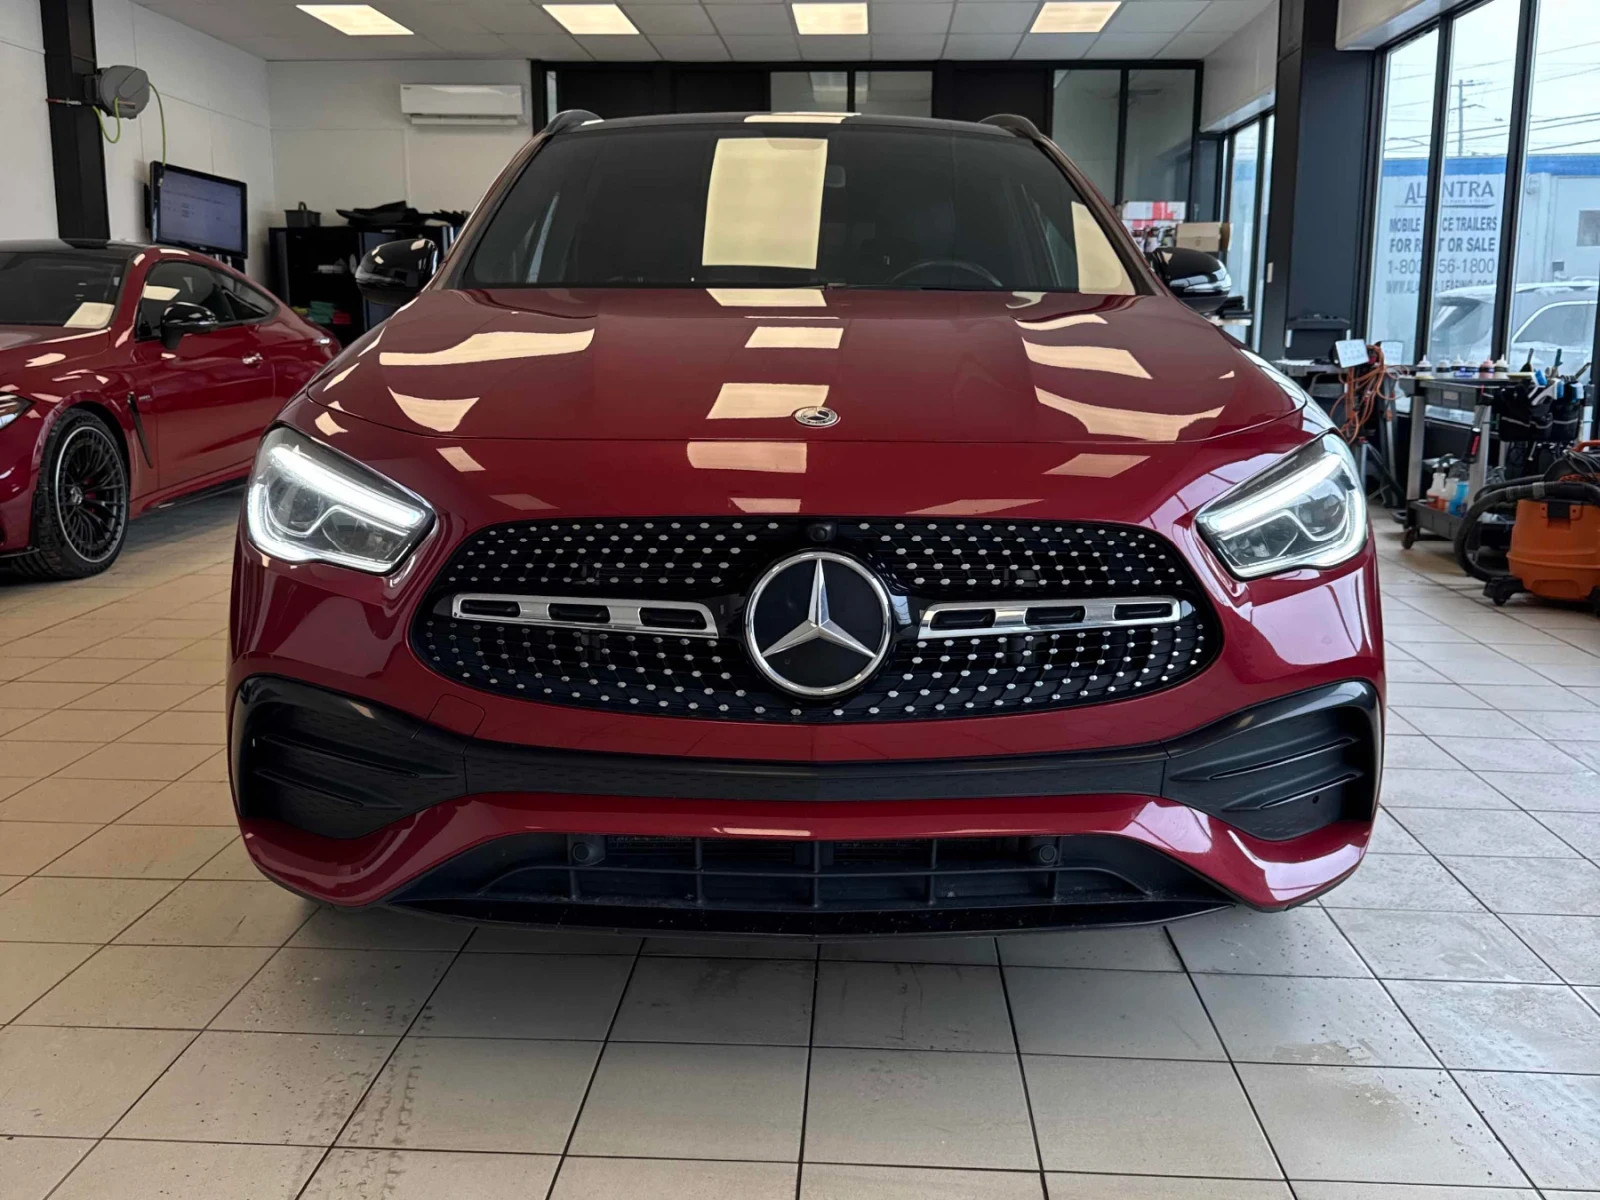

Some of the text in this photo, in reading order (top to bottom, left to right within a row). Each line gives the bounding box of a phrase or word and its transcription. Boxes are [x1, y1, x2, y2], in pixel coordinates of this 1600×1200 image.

[1404, 180, 1495, 204] ALNTRA
[1389, 217, 1421, 232] MOBILE
[1456, 216, 1498, 232] TRAILERS
[1389, 237, 1496, 253] FOR RT OR SALE
